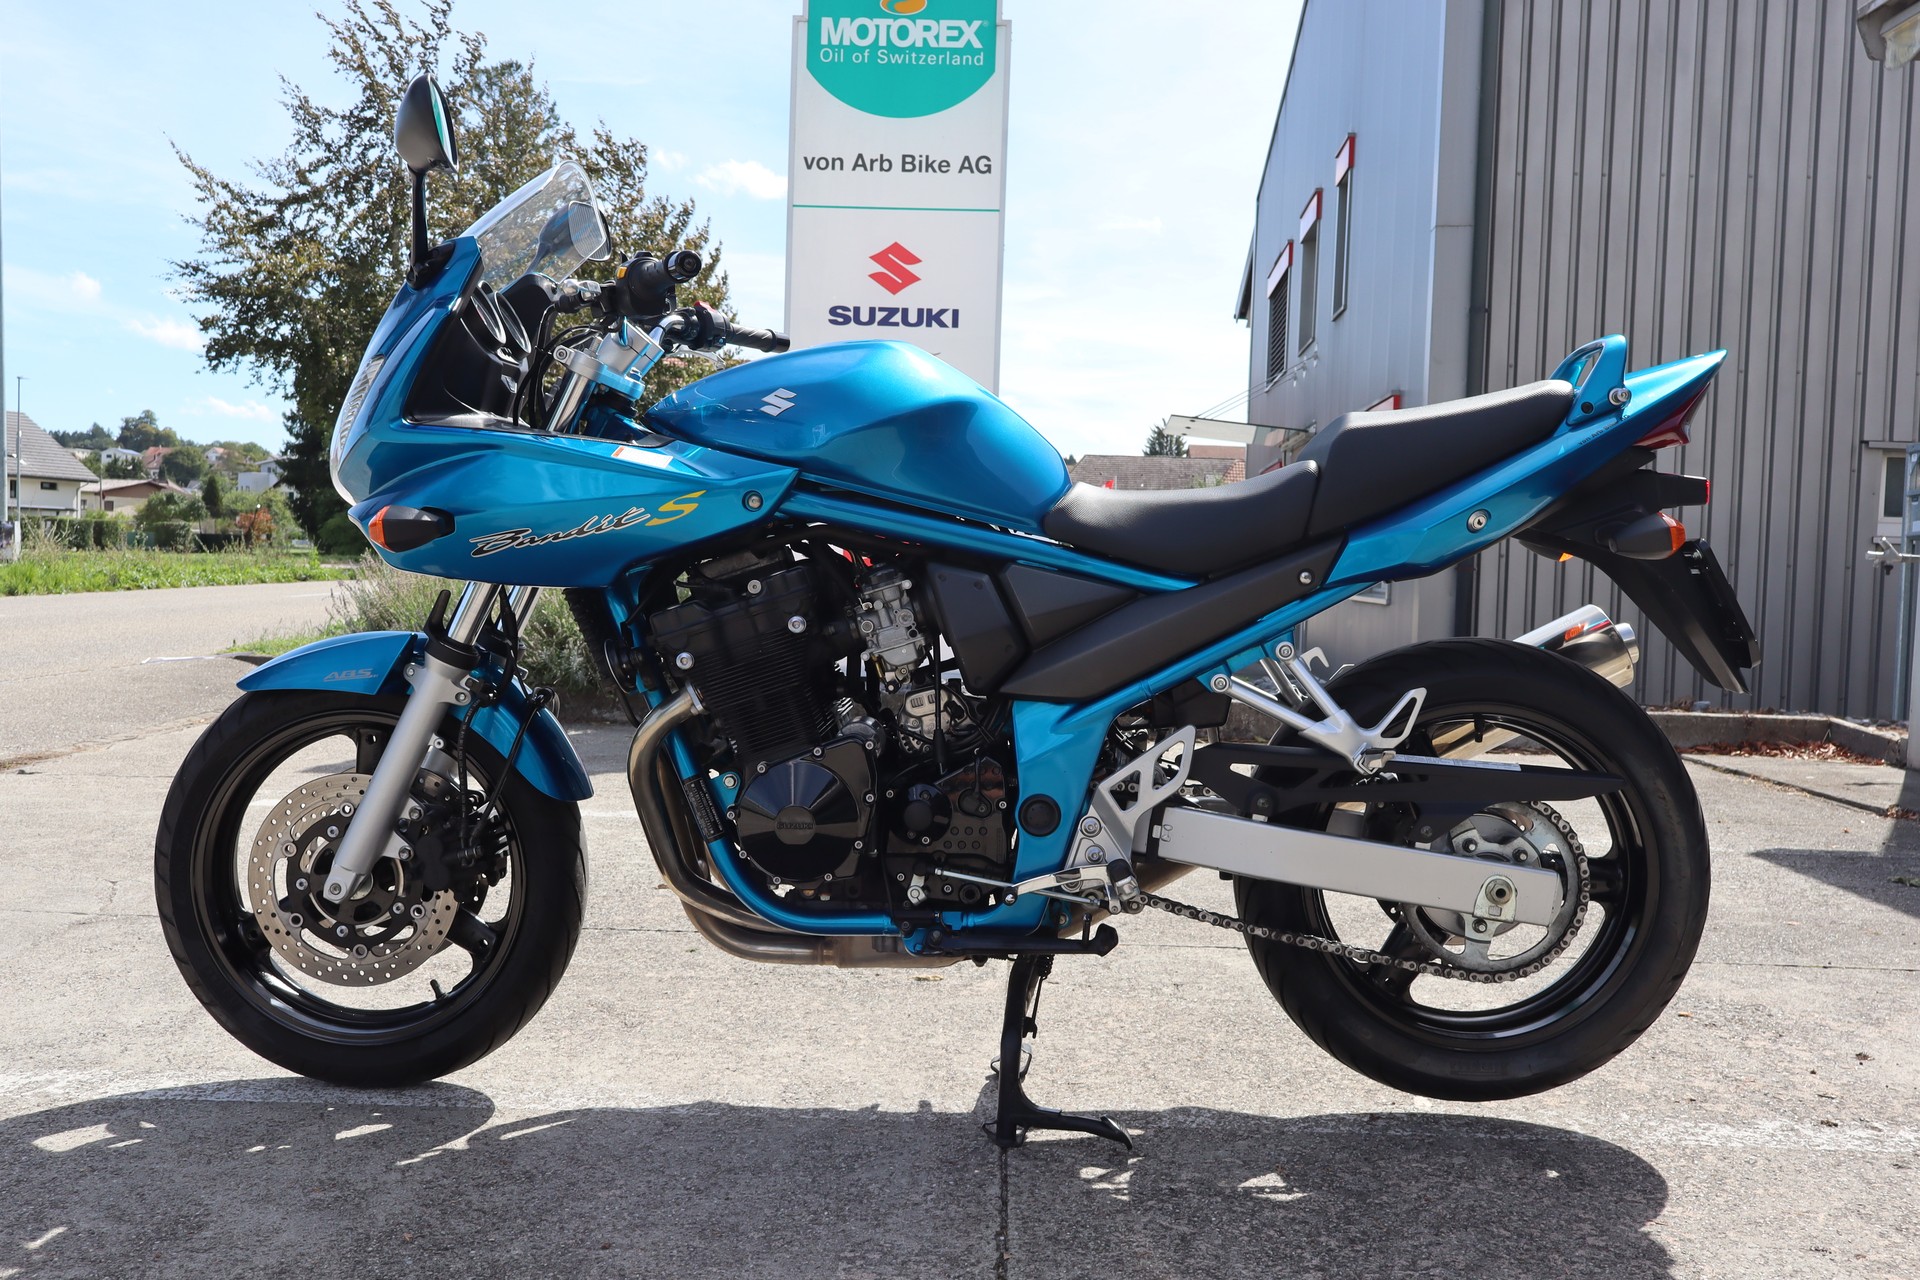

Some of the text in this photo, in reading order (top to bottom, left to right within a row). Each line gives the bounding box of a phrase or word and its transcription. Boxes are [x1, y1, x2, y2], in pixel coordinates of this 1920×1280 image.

[821, 17, 983, 49] MOTOREX
[820, 48, 984, 66] Oil of Switzerland
[803, 153, 992, 175] von Arb Bike AG
[828, 305, 959, 328] SUZUKI
[469, 490, 707, 557] Bandit S
[323, 668, 374, 682] ABS
[776, 821, 814, 830] SUZUKI
